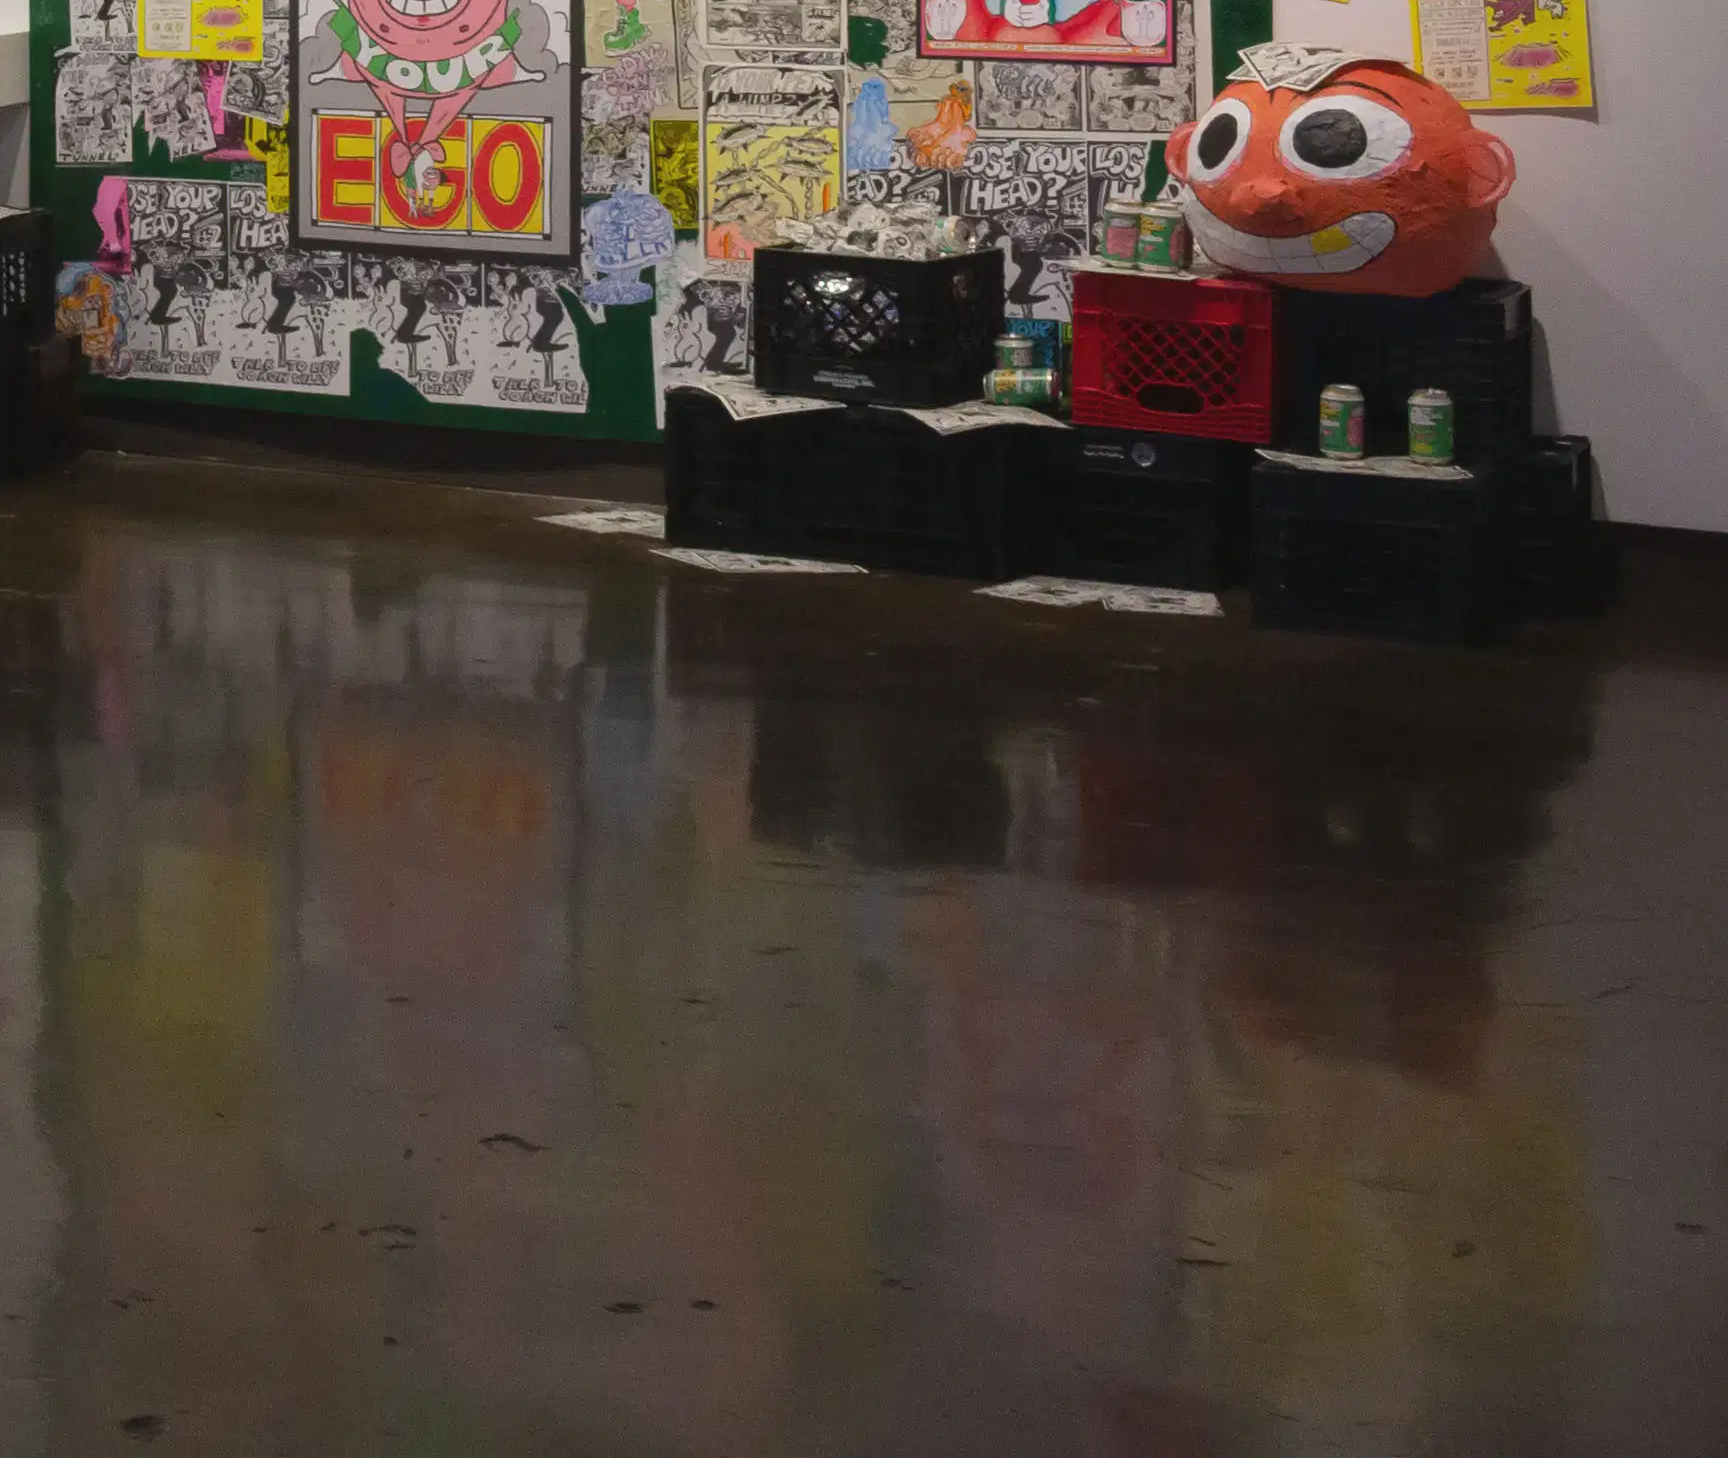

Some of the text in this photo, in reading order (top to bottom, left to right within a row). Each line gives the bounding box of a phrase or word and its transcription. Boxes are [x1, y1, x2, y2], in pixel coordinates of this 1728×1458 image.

[356, 33, 512, 94] YOUR
[318, 118, 543, 231] EGO
[1023, 142, 1087, 177] YOUR
[166, 183, 223, 211] YOUR
[971, 171, 1068, 213] HEAD?
